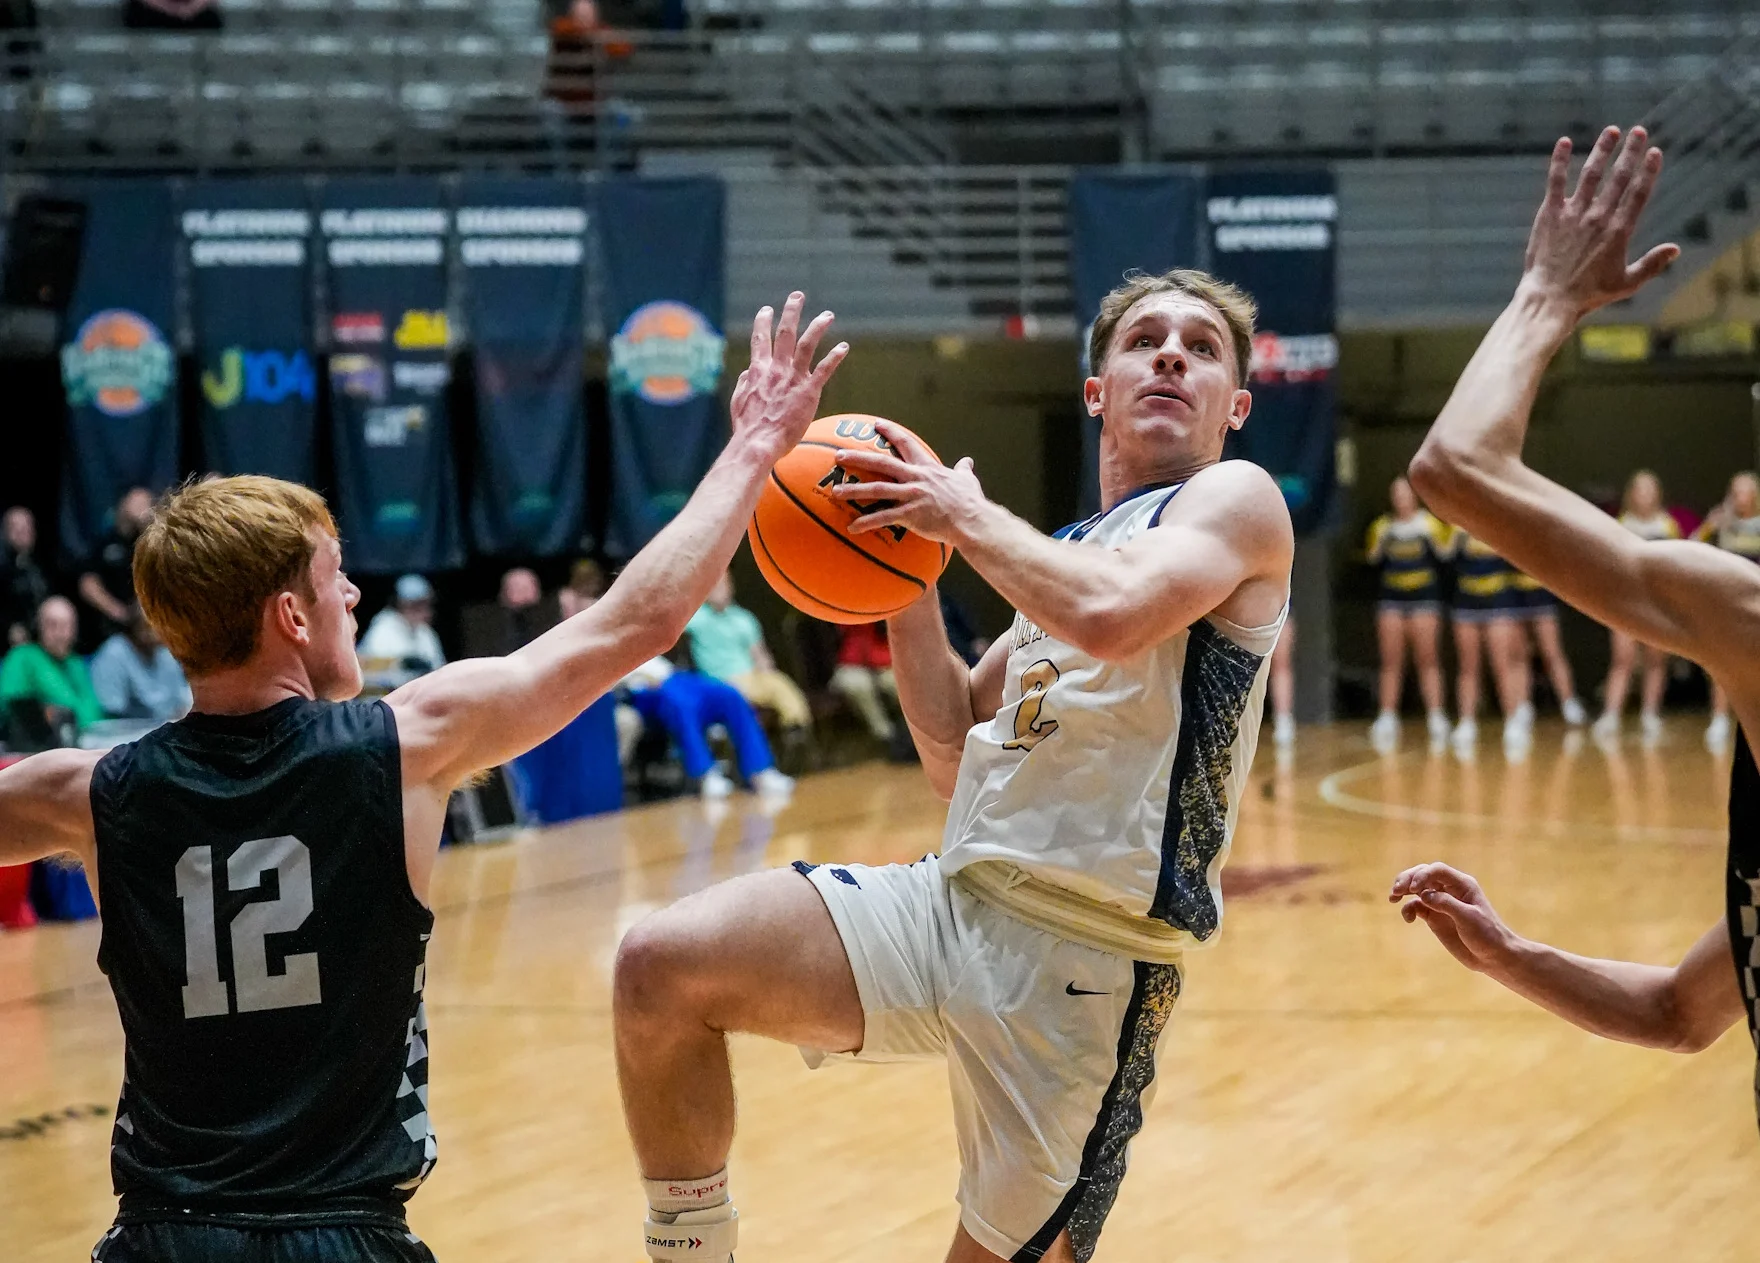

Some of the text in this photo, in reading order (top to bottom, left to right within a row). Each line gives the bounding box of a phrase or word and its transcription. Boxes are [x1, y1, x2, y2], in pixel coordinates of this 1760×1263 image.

[202, 349, 315, 408] J104
[1002, 659, 1060, 752] 2
[175, 834, 322, 1019] 12
[668, 1178, 728, 1198] Supre
